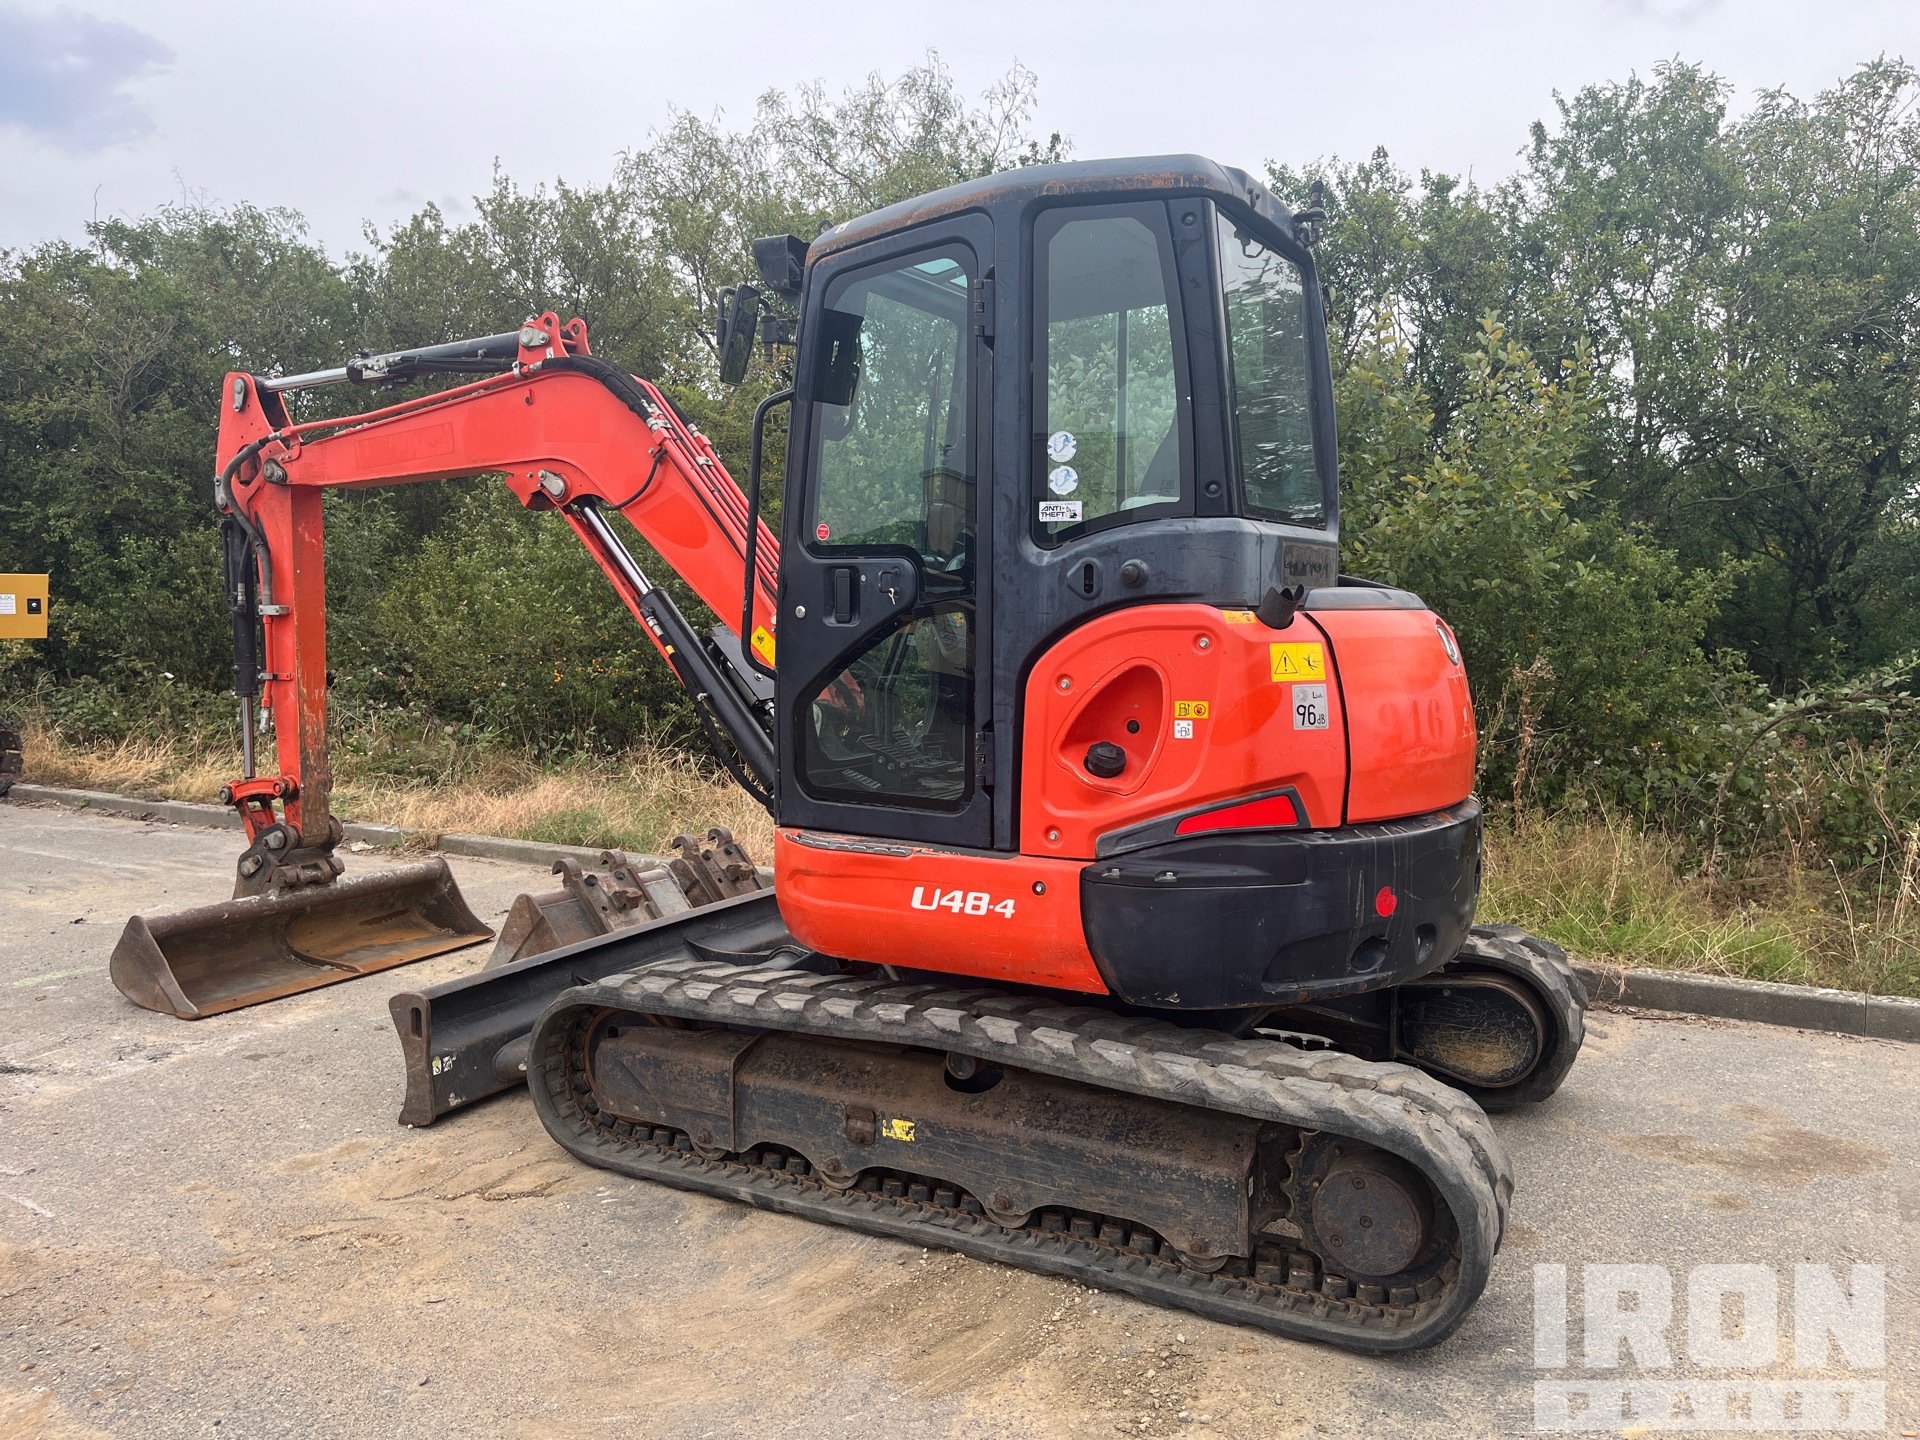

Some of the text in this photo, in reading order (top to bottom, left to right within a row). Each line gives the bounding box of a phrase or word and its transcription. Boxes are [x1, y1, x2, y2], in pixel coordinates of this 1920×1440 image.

[1296, 703, 1326, 726] 96 dB
[911, 886, 1016, 918] U48-4
